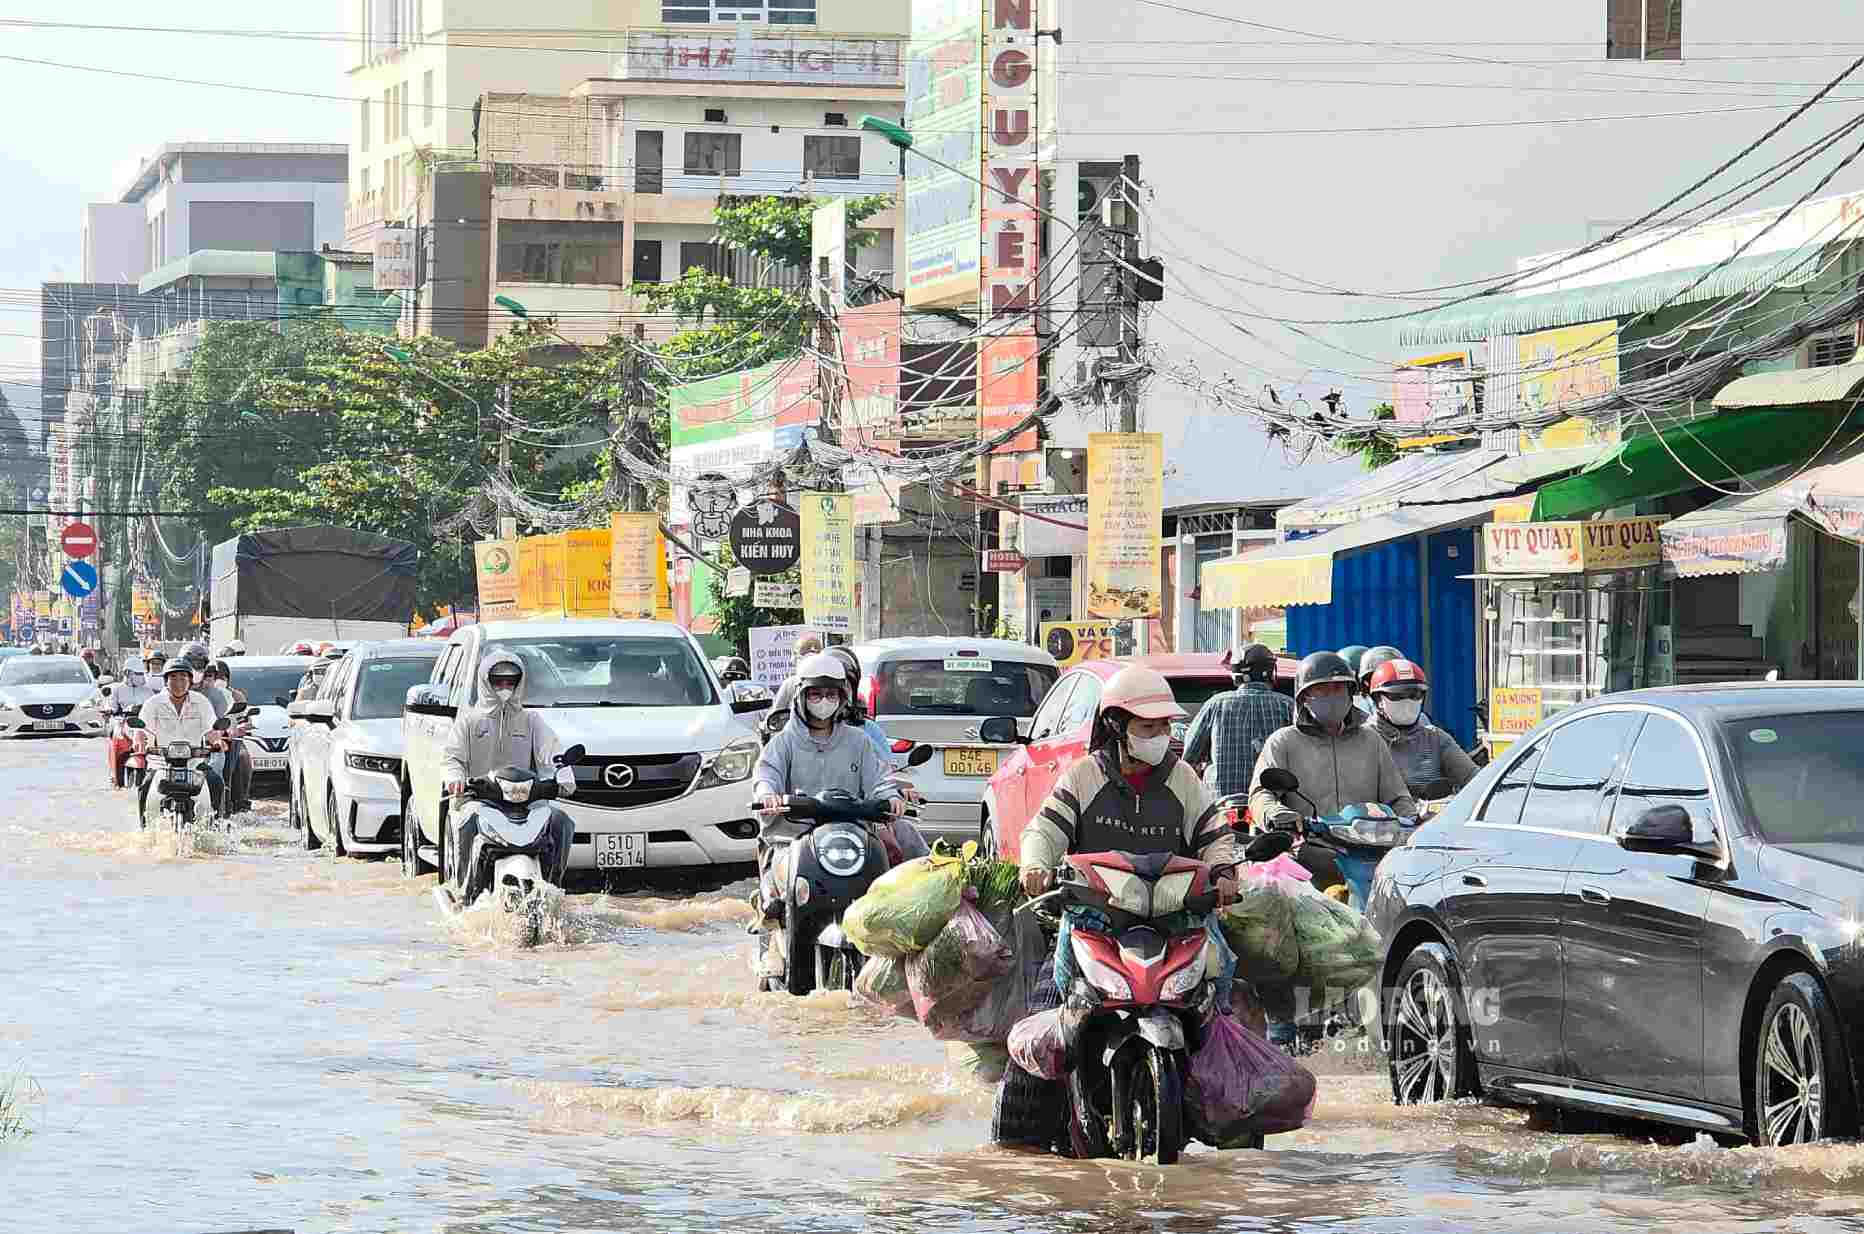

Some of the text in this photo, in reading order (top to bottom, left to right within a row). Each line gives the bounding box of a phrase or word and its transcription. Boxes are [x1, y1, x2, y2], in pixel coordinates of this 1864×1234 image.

[1526, 527, 1575, 553] QUAY
[771, 544, 794, 559] HUY
[607, 836, 633, 850] 51D
